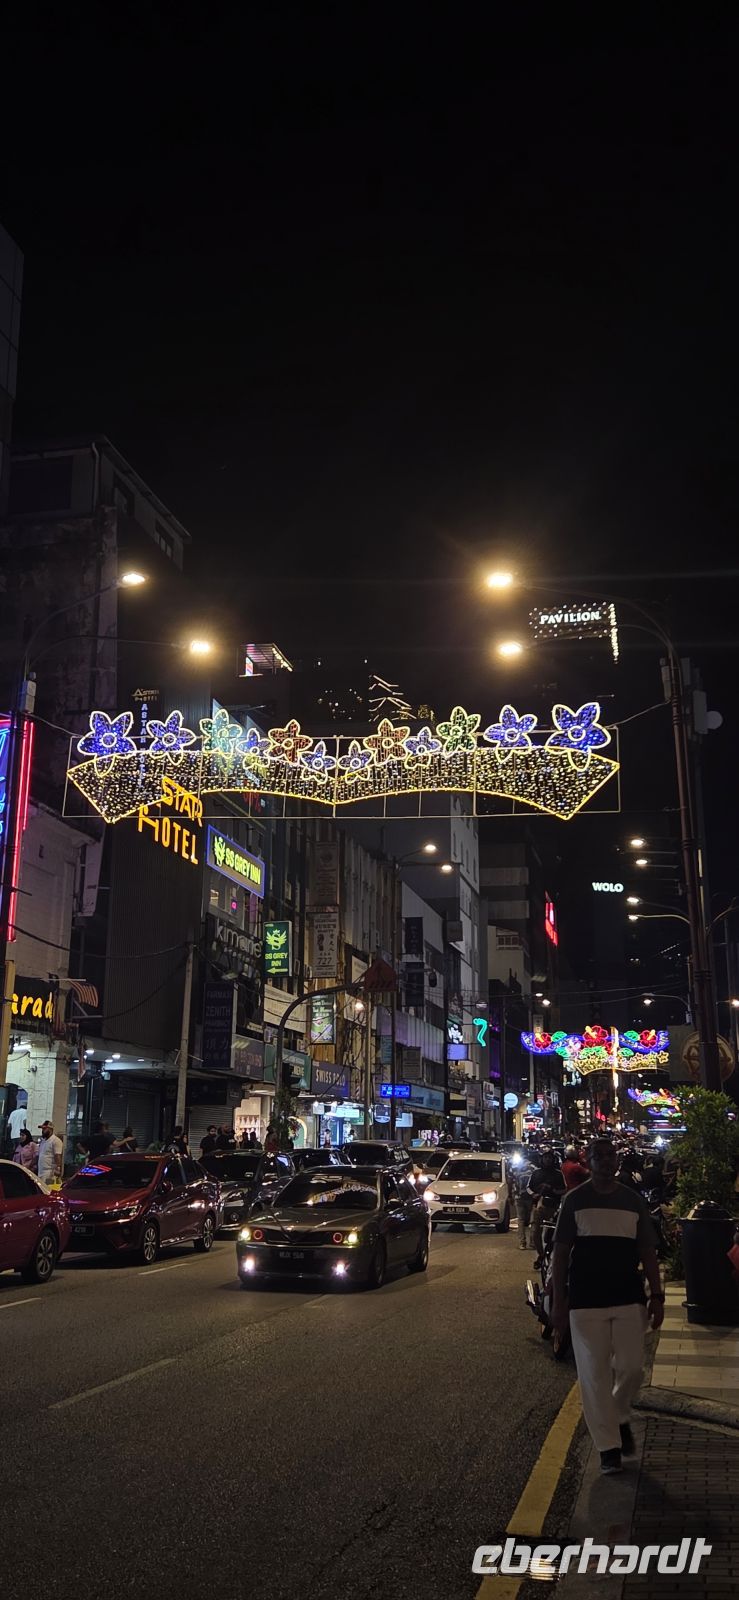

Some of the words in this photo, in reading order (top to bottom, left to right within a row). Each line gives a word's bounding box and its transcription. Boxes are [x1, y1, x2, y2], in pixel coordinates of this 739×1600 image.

[539, 611, 602, 624] PAVILION
[138, 804, 198, 865] HOTEL
[225, 847, 235, 868] SS
[234, 853, 250, 878] GREY
[250, 863, 261, 885] INN
[592, 882, 624, 893] WOLO
[272, 952, 288, 960] GREY
[205, 1007, 231, 1017] ZENITH
[315, 1069, 332, 1084] SWISS
